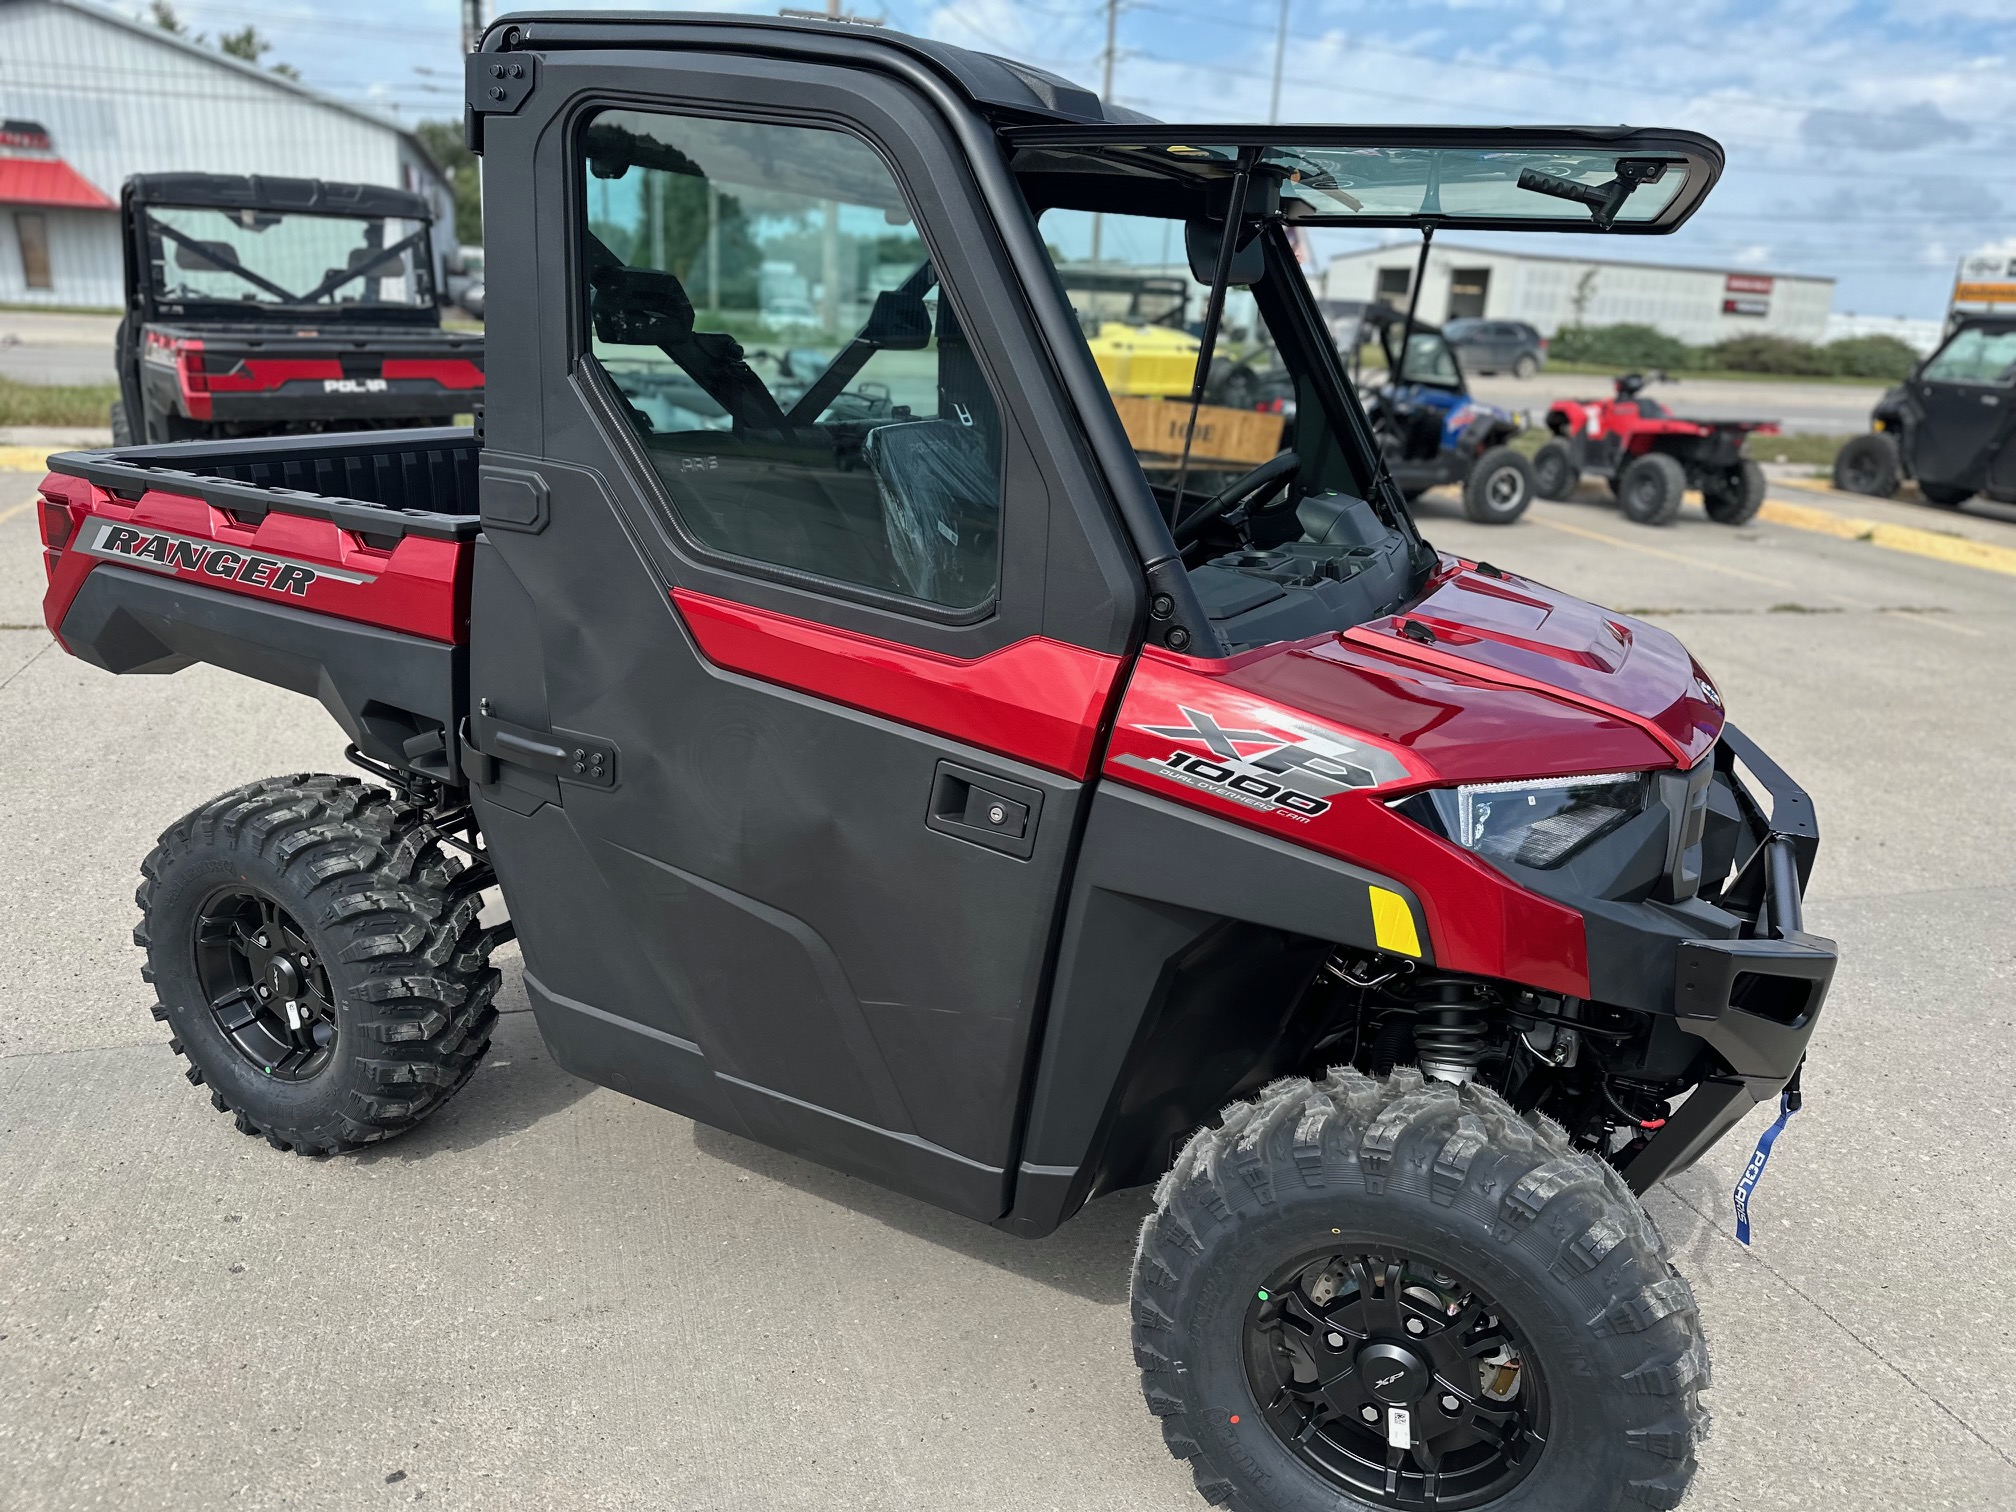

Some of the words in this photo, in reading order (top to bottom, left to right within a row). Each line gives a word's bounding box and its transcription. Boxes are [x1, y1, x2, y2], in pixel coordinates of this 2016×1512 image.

[100, 524, 317, 597] RANGER
[1128, 704, 1379, 790] XP
[1158, 768, 1195, 785] DUAL
[1197, 783, 1276, 811] OVERHEAD
[1276, 809, 1311, 824] CAM
[1166, 750, 1332, 818] 1000
[1734, 1150, 1766, 1226] POLARIS
[1373, 1370, 1405, 1390] XP
